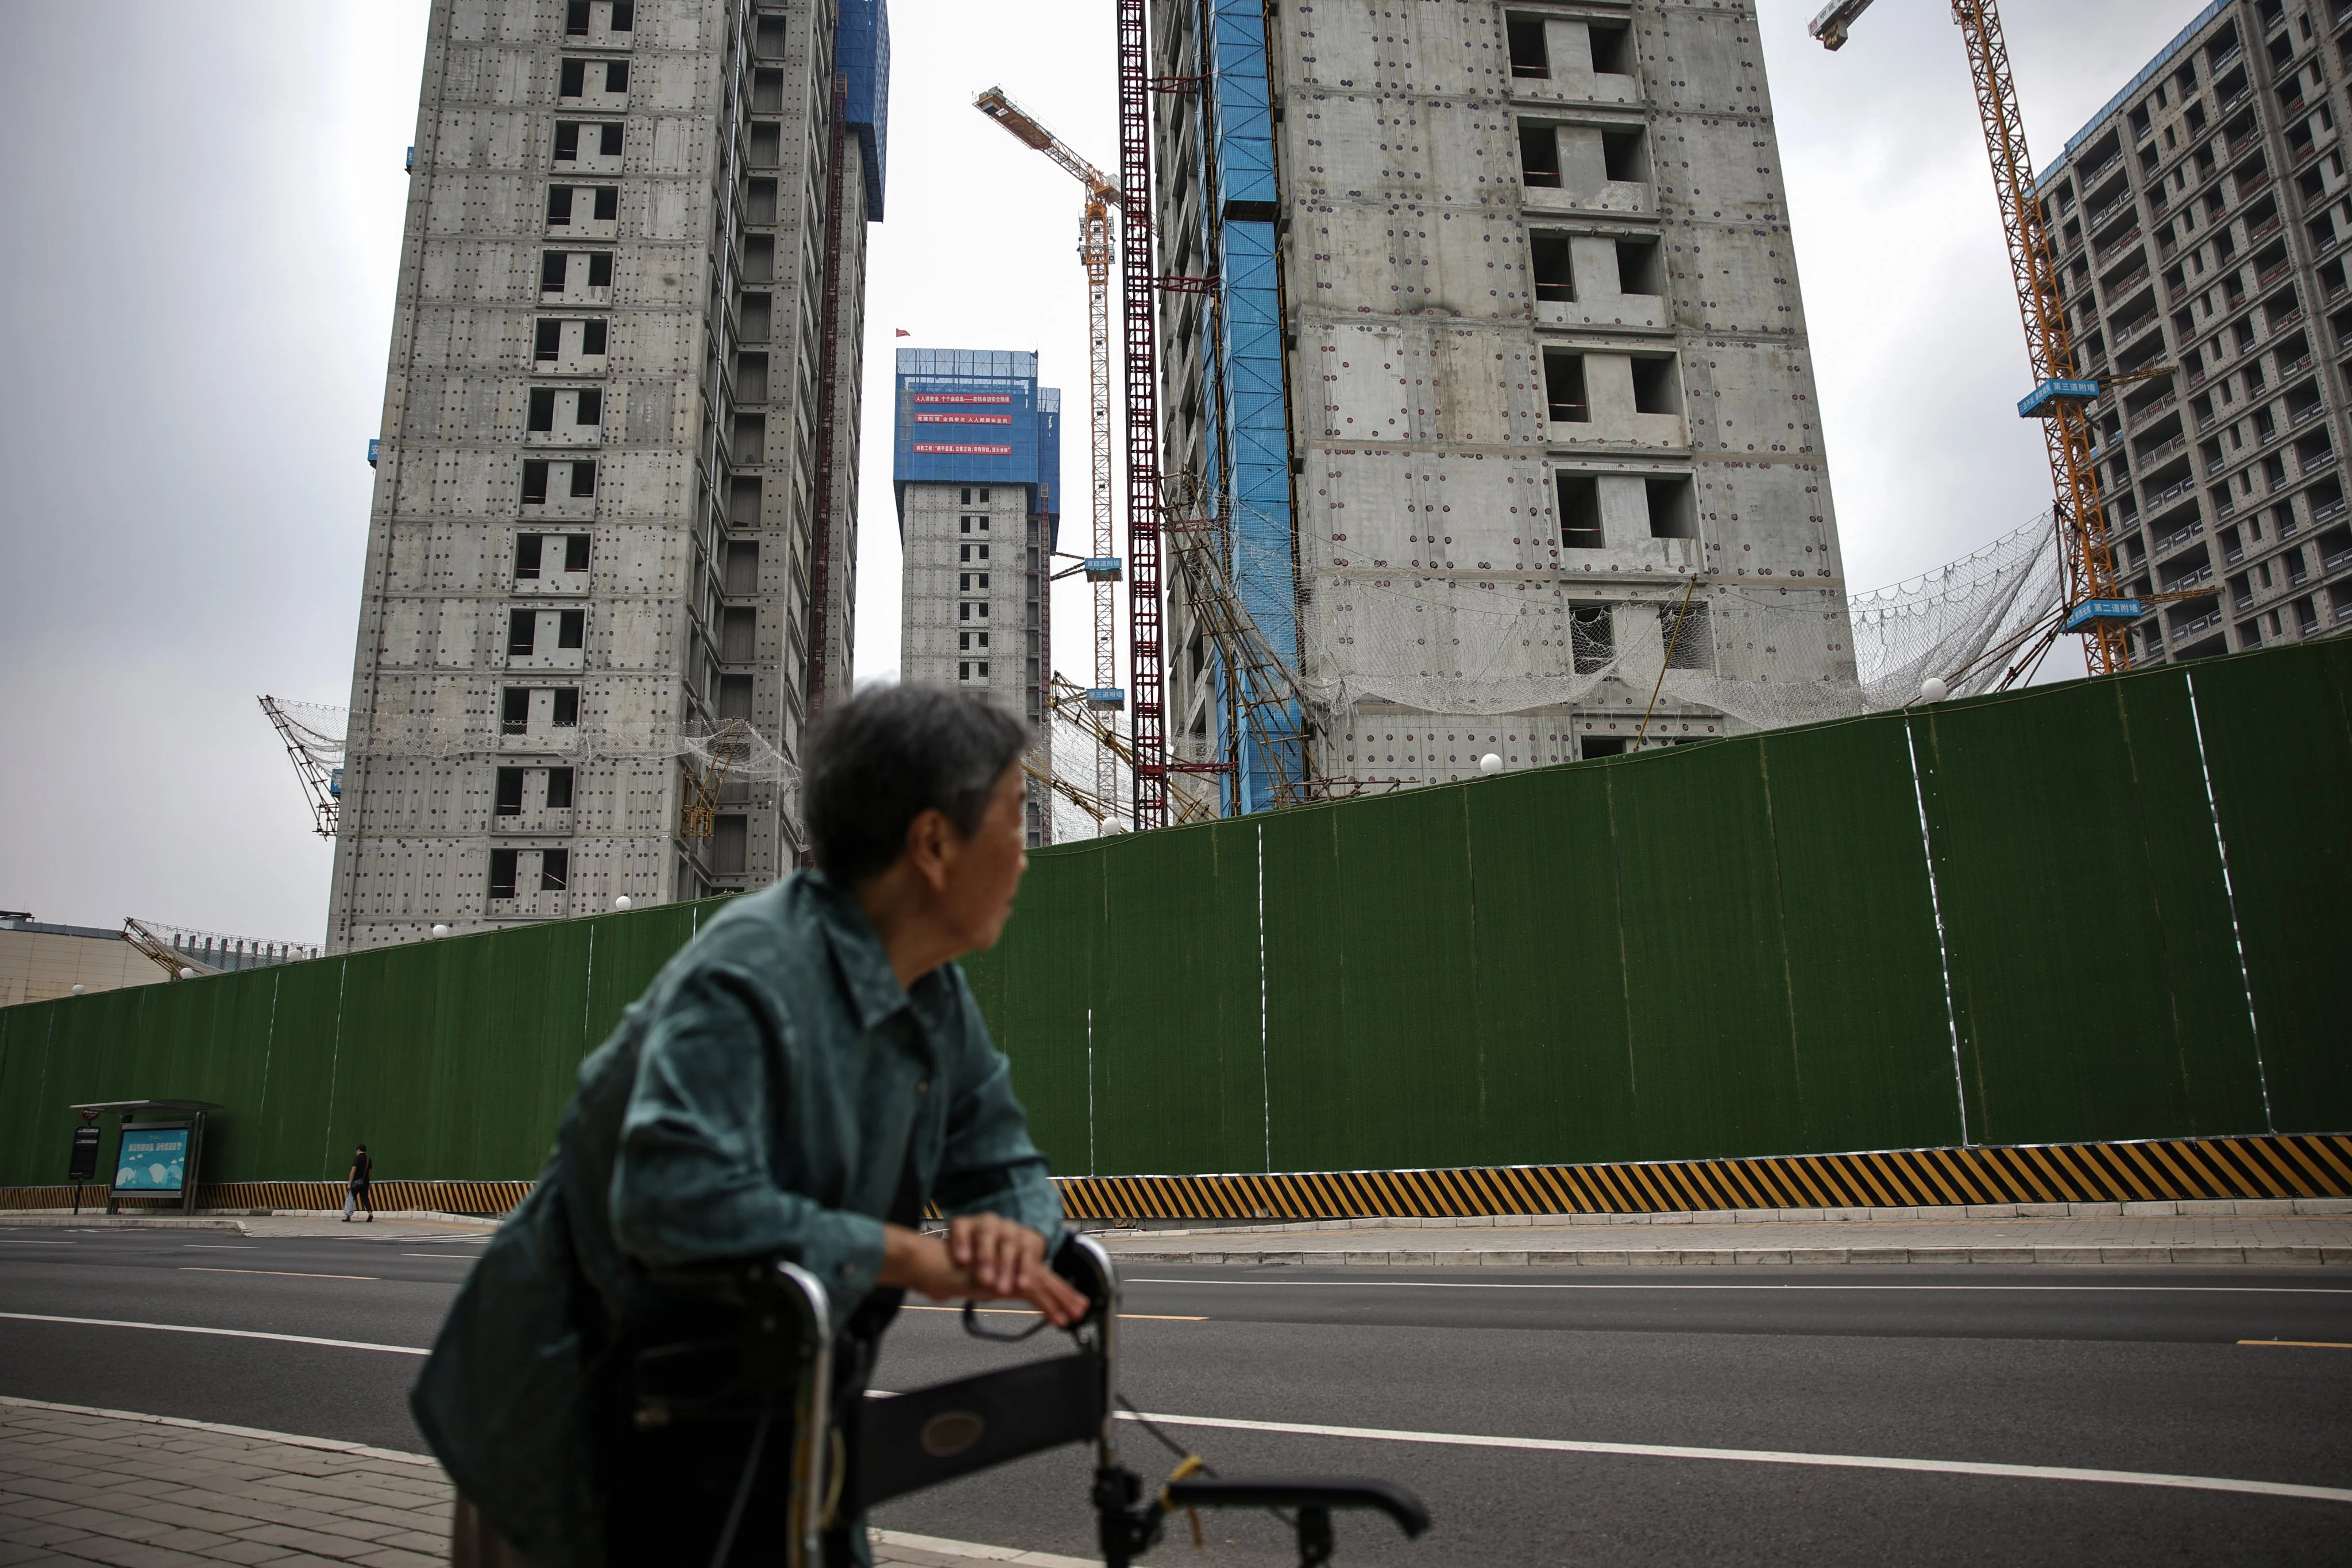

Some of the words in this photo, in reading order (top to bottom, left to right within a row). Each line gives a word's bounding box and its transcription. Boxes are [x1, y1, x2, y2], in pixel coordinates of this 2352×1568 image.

[2053, 382, 2096, 392] 第三道附墙
[2094, 603, 2138, 613] 第二道附墙
[1089, 690, 1123, 698] 第三道附墙
